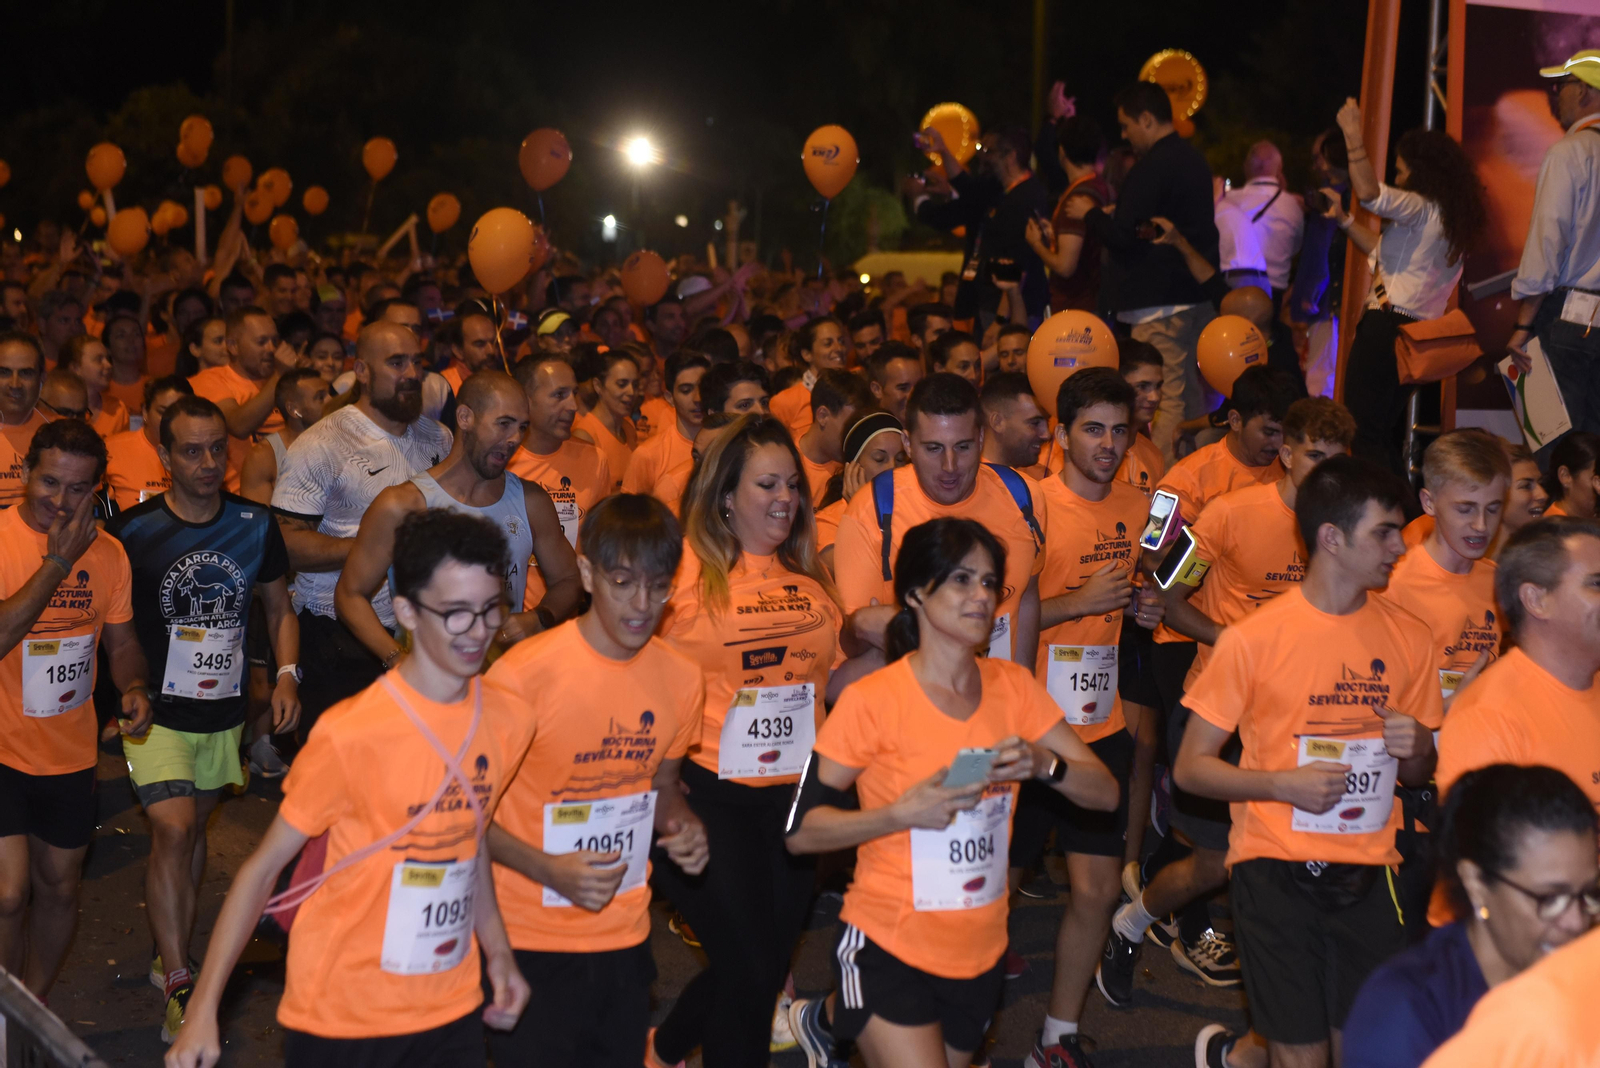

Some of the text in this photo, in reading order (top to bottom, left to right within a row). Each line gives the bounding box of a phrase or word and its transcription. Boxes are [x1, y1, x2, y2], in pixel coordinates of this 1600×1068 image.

[1094, 541, 1132, 551] NOCTURNA
[1080, 552, 1111, 564] SEVILLA
[161, 570, 180, 614] TIRADA
[177, 553, 219, 571] LARGA
[52, 590, 93, 598] OCTURNA
[757, 596, 810, 605] NOCTURNA
[737, 604, 786, 614] SEVILLA
[193, 652, 233, 670] 3495
[46, 658, 91, 684] 18574
[1070, 672, 1110, 691] 15472
[1334, 682, 1390, 694] NOCTURNA
[1308, 694, 1359, 706] SEVILLA
[748, 716, 793, 739] 4339
[602, 736, 656, 747] NOCTURNA
[573, 749, 623, 764] SEVILLA
[574, 828, 634, 853] 10951
[950, 834, 994, 864] 8084
[422, 893, 472, 928] 1093
